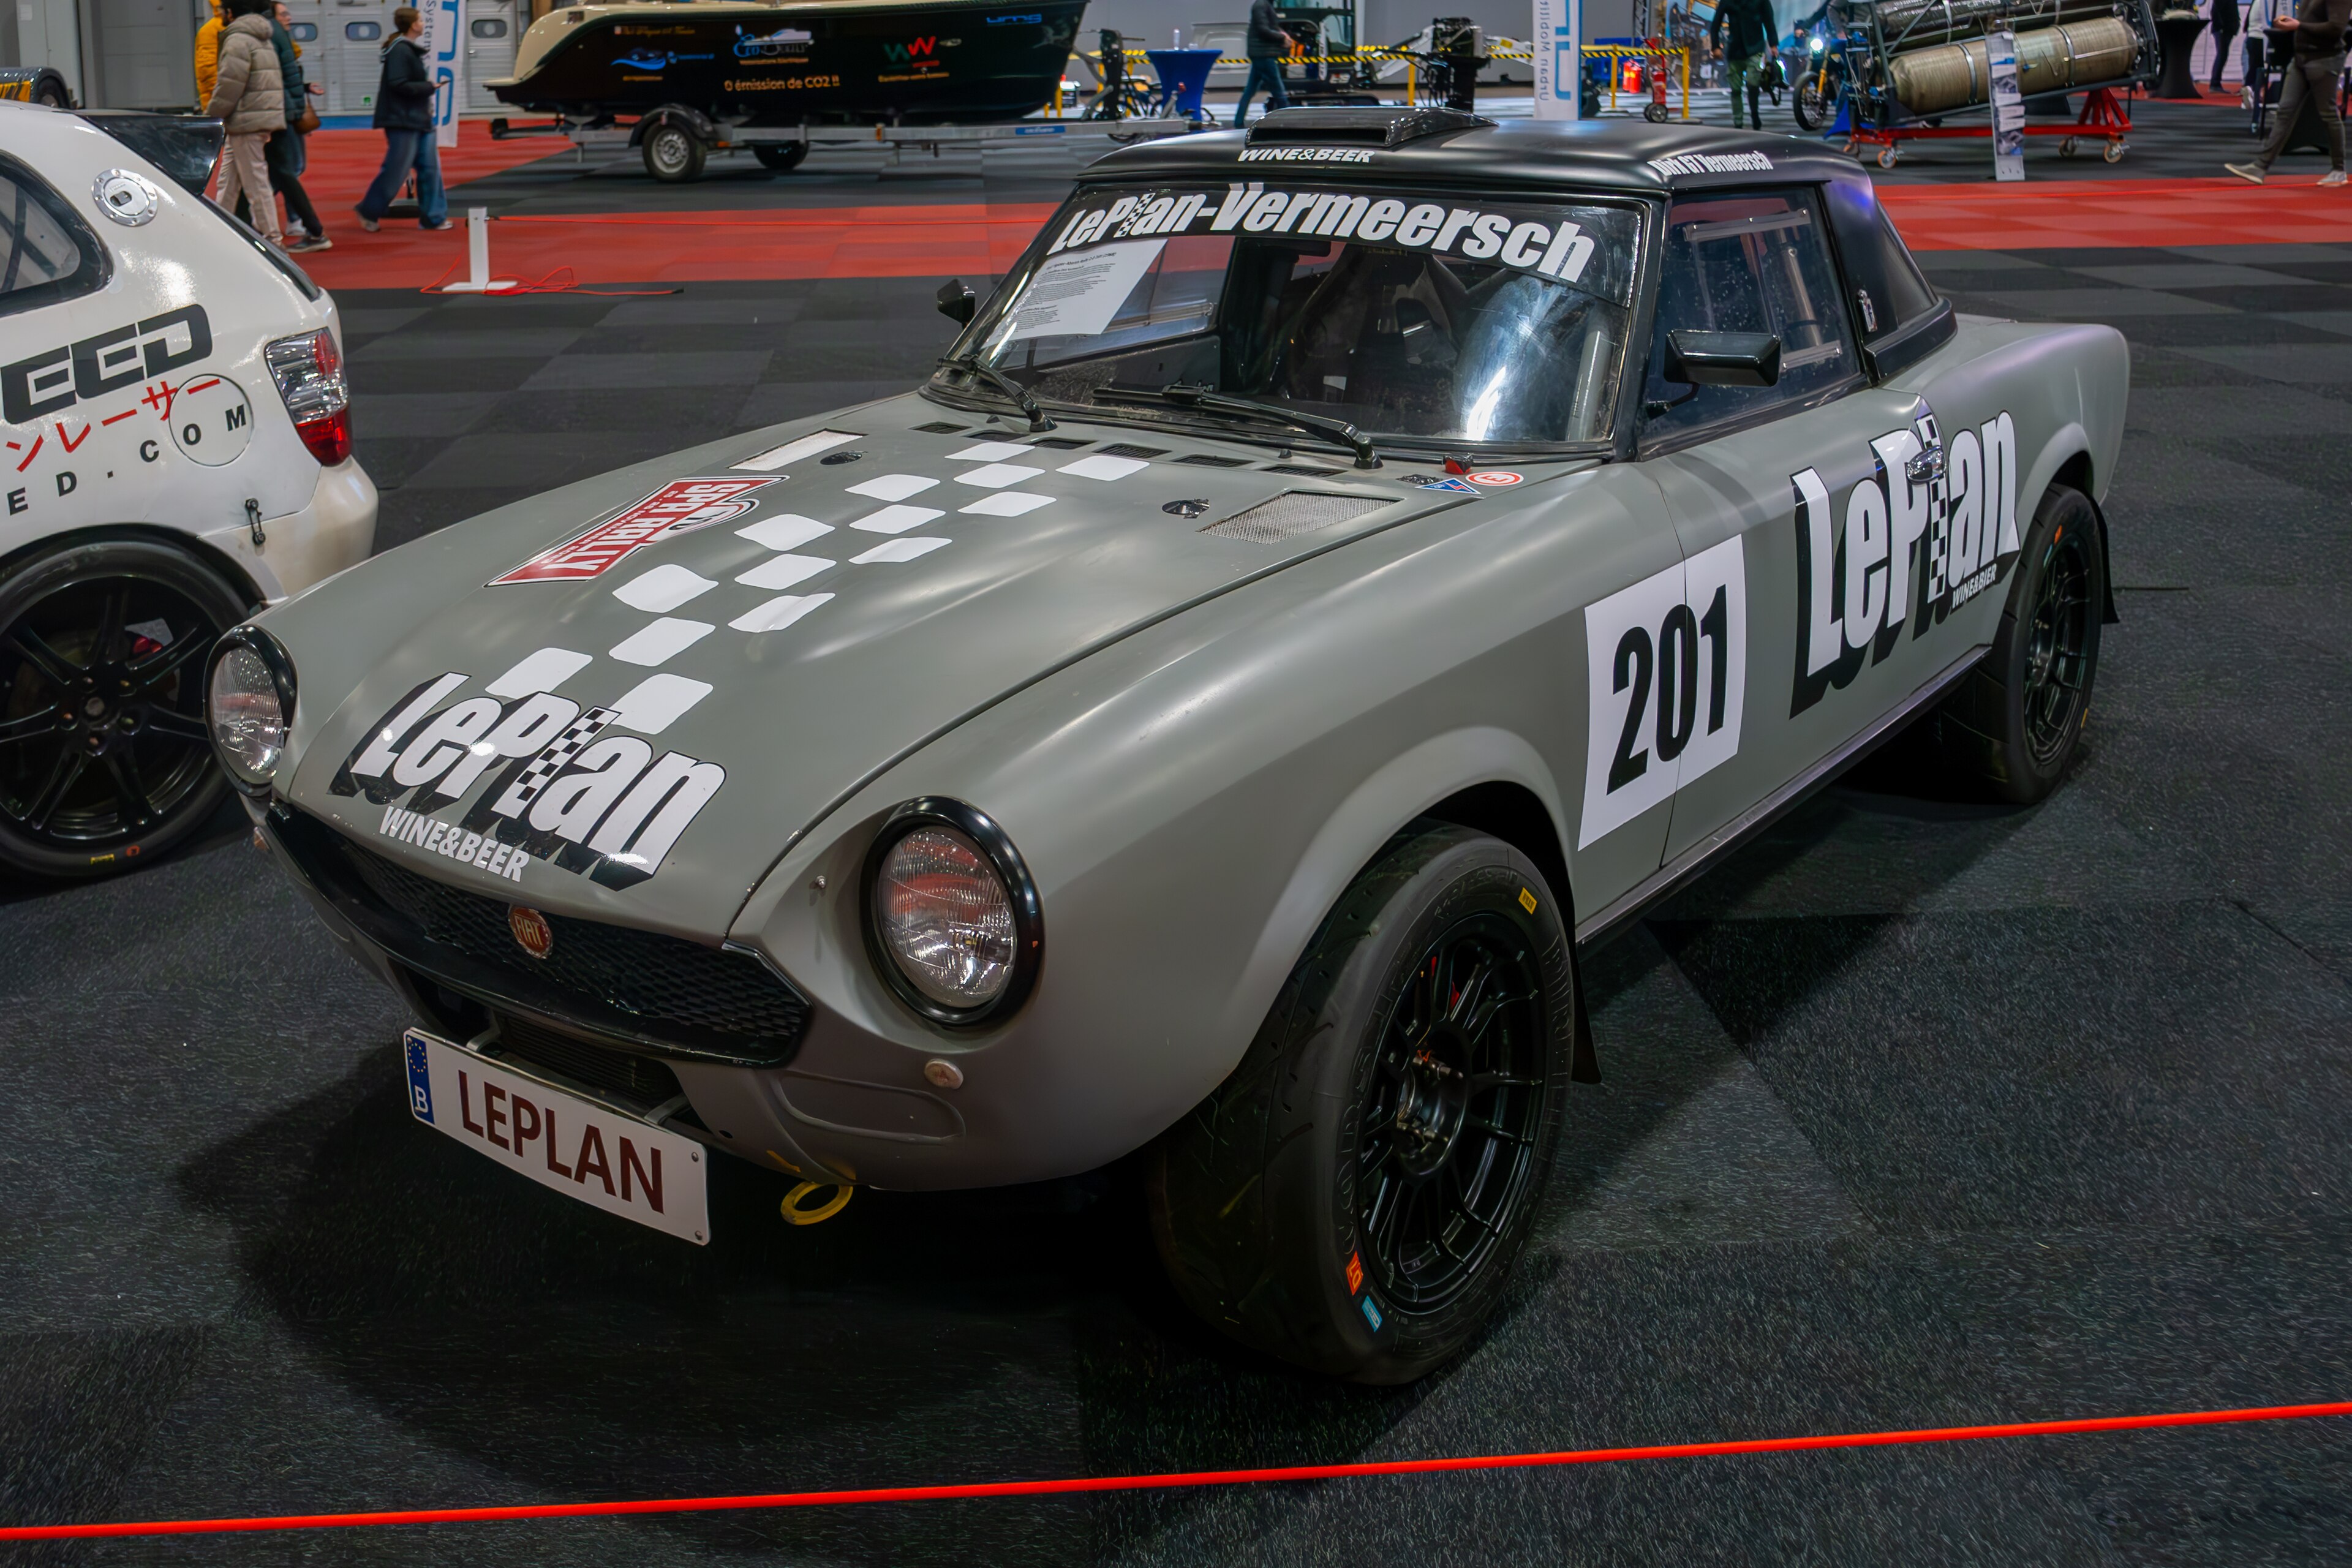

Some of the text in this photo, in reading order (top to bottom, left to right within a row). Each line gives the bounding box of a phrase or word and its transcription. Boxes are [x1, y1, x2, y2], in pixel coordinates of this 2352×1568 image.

[787, 77, 803, 89] de
[804, 75, 831, 89] CO2
[1237, 148, 1375, 164] WINE&BEER
[1647, 158, 1691, 176] Dirk
[1693, 150, 1774, 173] Vermeersch
[541, 483, 752, 571] SPA RALLY
[1790, 409, 2019, 680] LePlan
[1952, 563, 1997, 609] WINE&BIER
[1606, 584, 1728, 796] 201
[336, 671, 727, 879] LePlan
[379, 805, 530, 883] WINE&BEER
[514, 914, 543, 946] FIAT
[415, 1085, 429, 1114] B
[458, 1069, 666, 1216] LEPLAN
